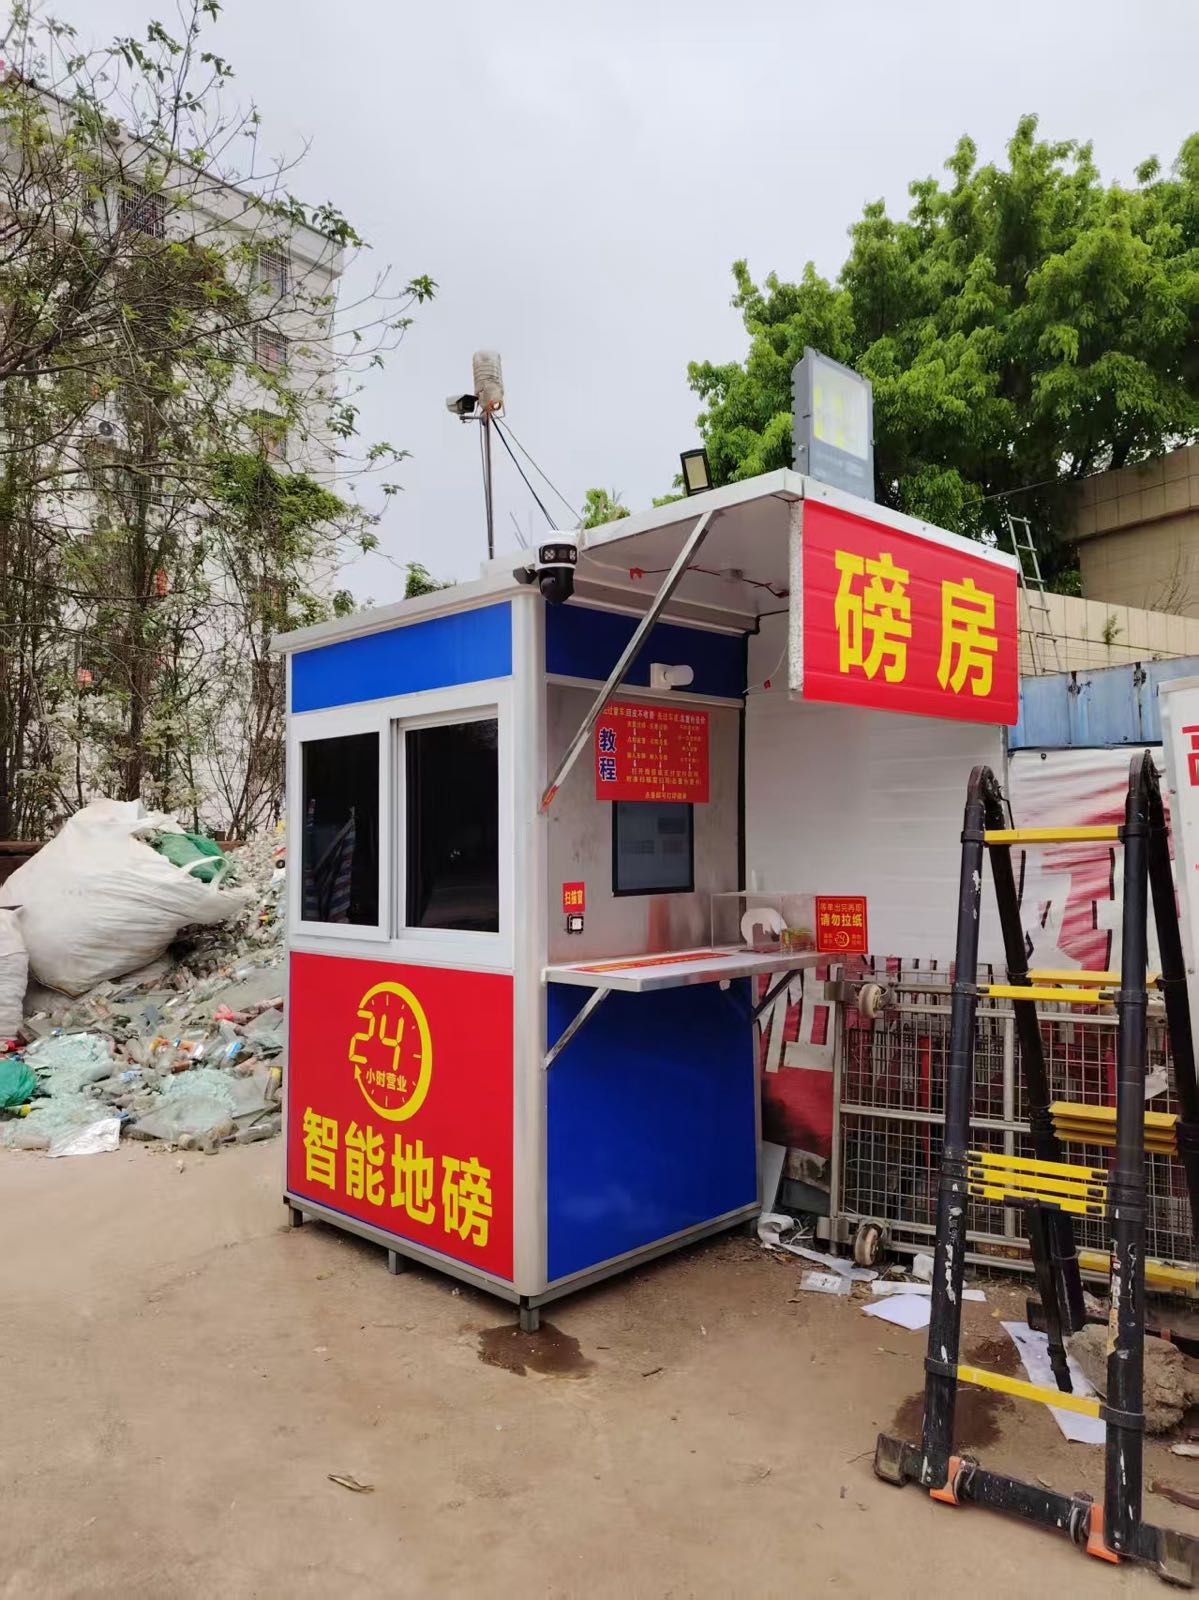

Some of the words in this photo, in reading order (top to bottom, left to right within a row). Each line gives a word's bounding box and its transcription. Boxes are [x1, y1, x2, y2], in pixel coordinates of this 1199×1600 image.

[834, 549, 998, 697] 磅房
[599, 727, 617, 782] 教程
[820, 912, 863, 928] 请勿拉纸
[349, 1008, 405, 1072] 24
[365, 1067, 408, 1093] 小时营业
[302, 1107, 494, 1248] 智能地磅
